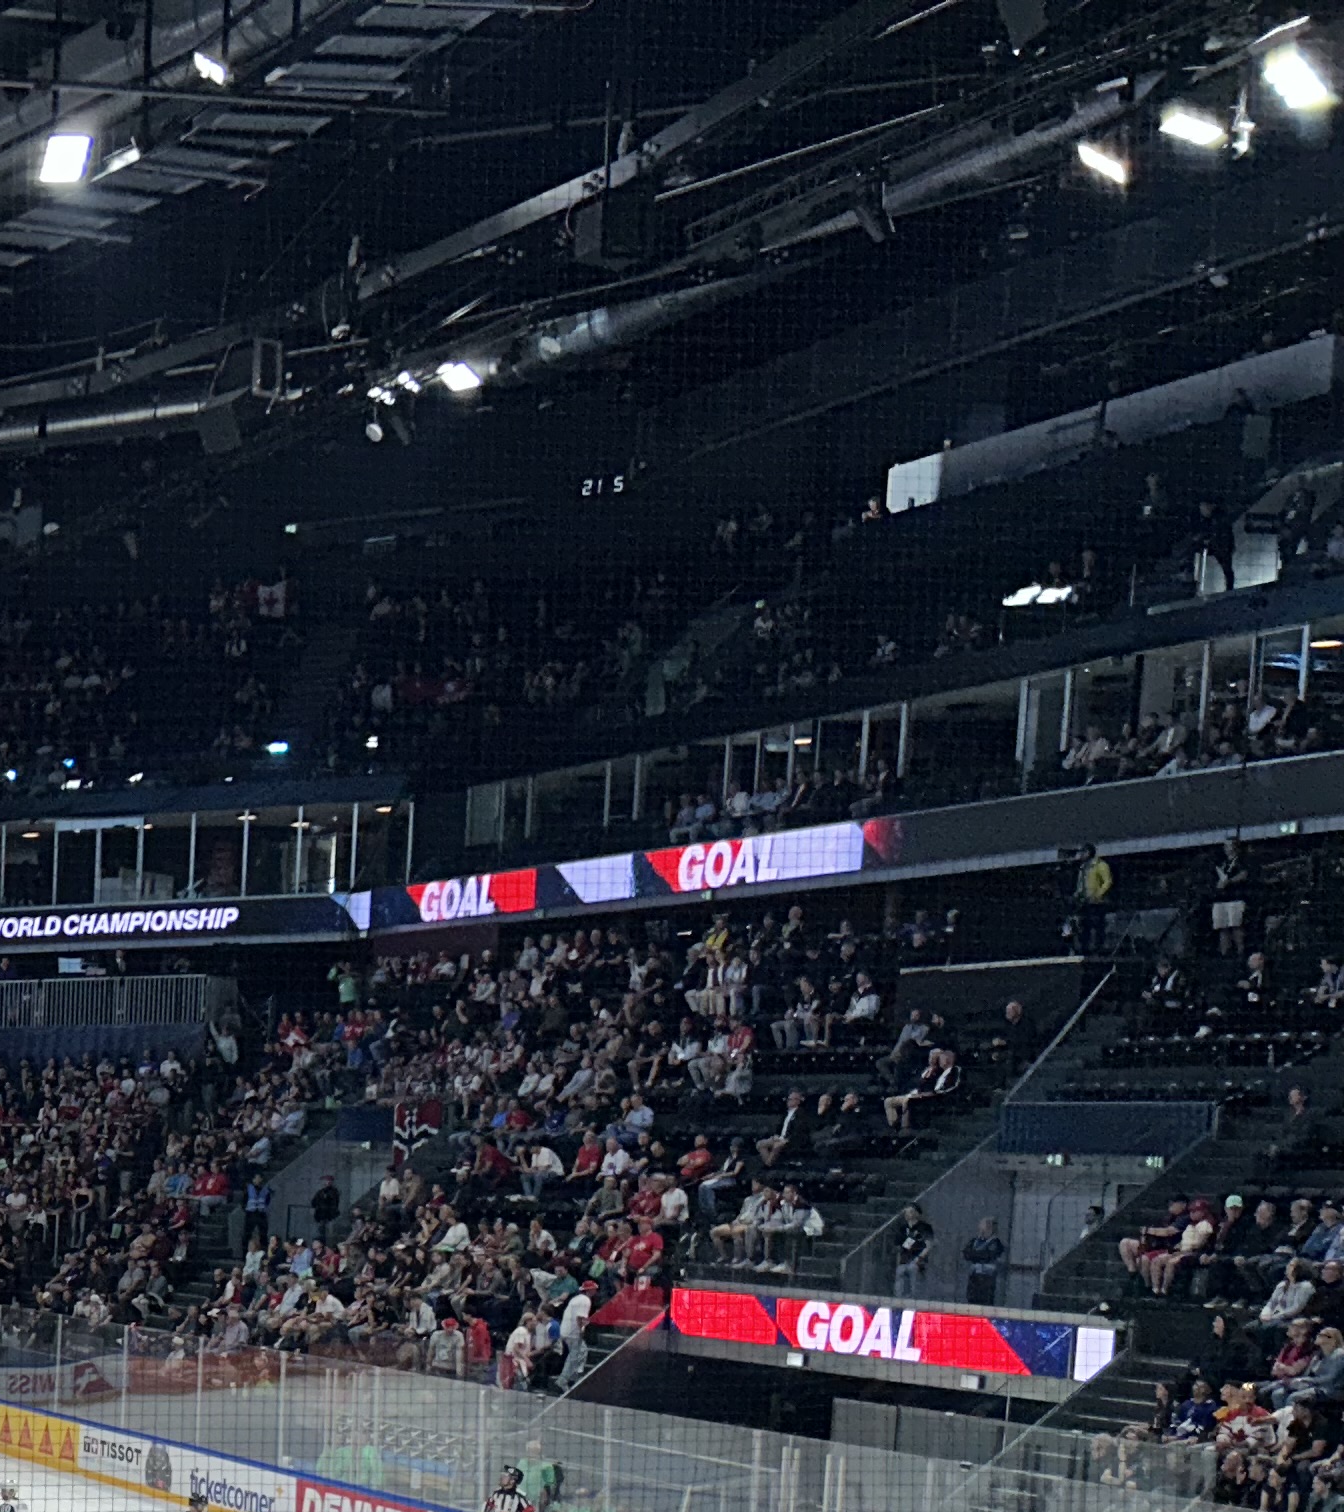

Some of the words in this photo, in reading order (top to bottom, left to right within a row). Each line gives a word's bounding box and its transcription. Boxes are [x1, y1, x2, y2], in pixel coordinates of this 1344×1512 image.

[679, 837, 779, 891] GOAL
[64, 906, 240, 936] CHAMPIONSHIP
[419, 873, 496, 923] GOAL
[796, 1301, 923, 1363] GOAL
[99, 1440, 142, 1466] TISSOT
